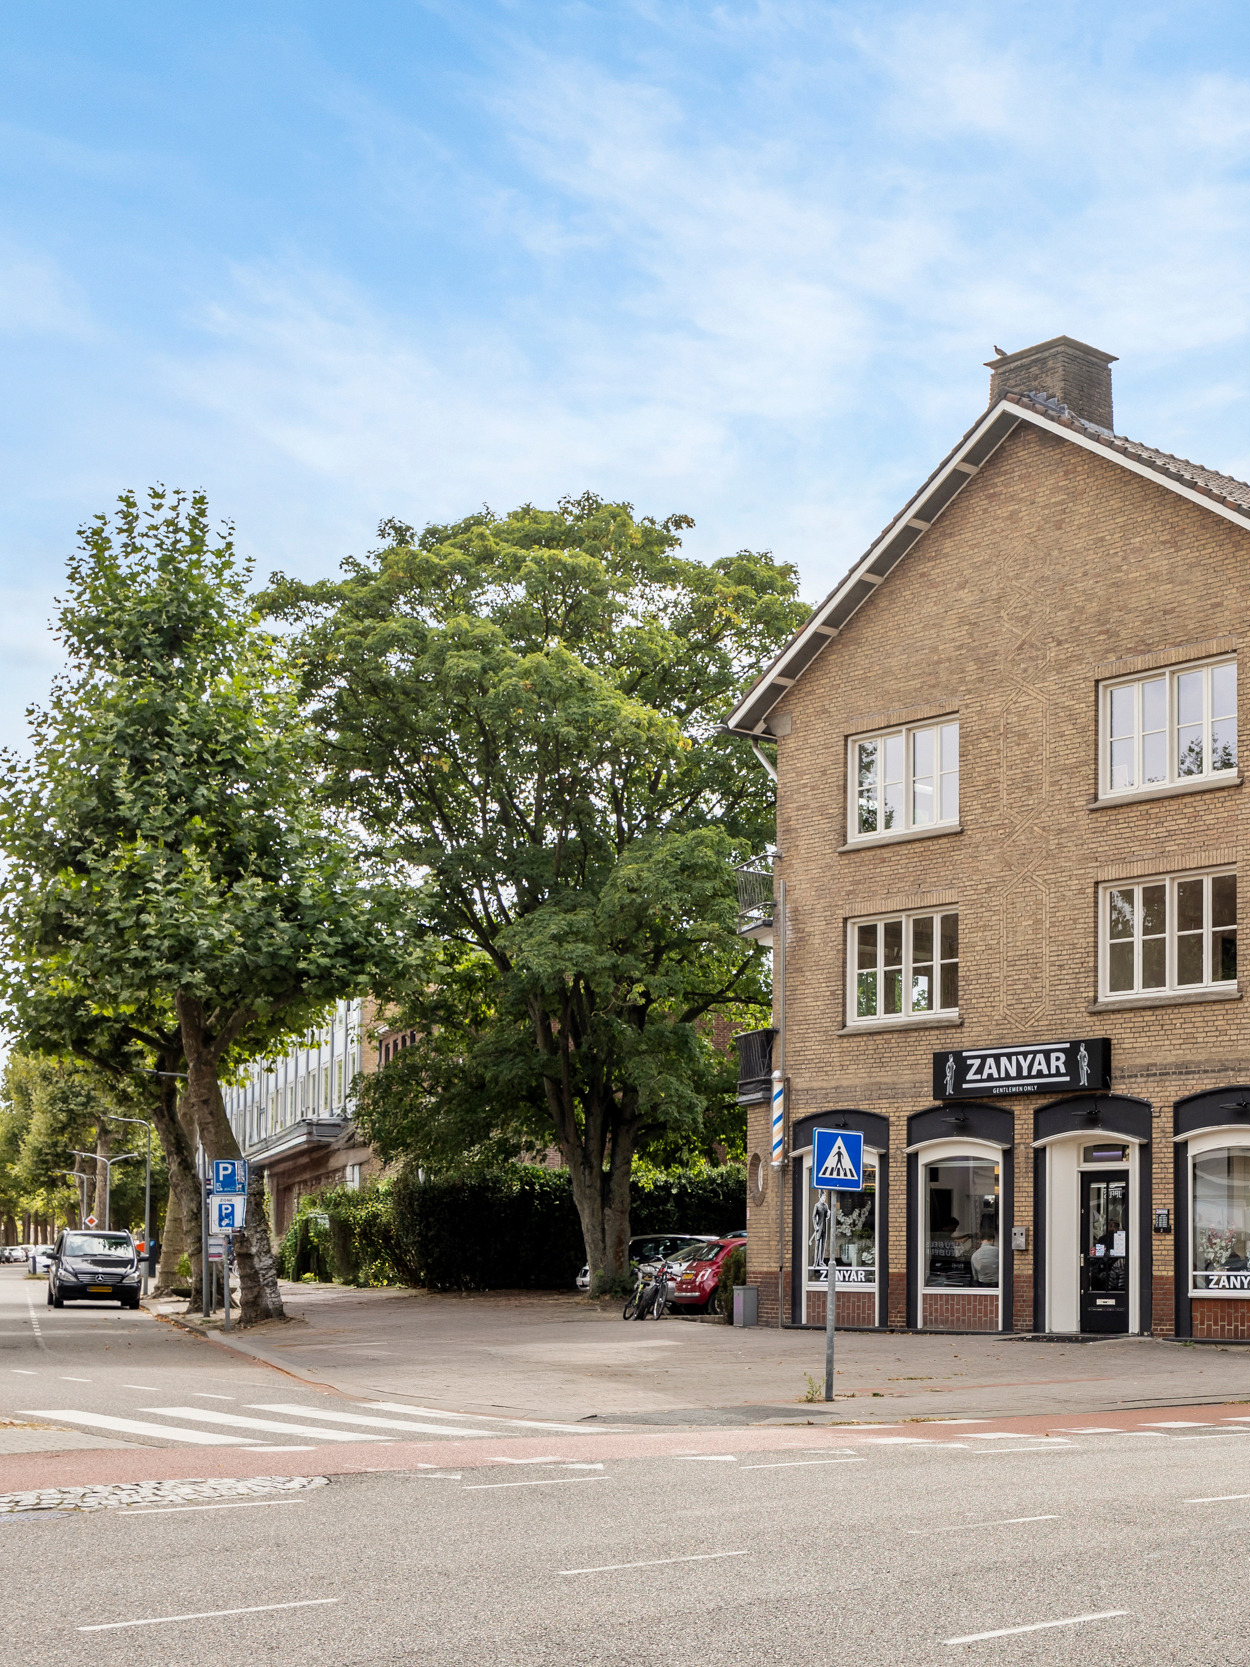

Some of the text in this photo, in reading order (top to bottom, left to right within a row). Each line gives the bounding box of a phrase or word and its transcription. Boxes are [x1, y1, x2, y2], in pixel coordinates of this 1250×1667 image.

[966, 1052, 1066, 1080] ZANYAR
[992, 1086, 1023, 1094] GENTLEMEN
[219, 1163, 232, 1181] P
[820, 1270, 865, 1282] ZNYAR
